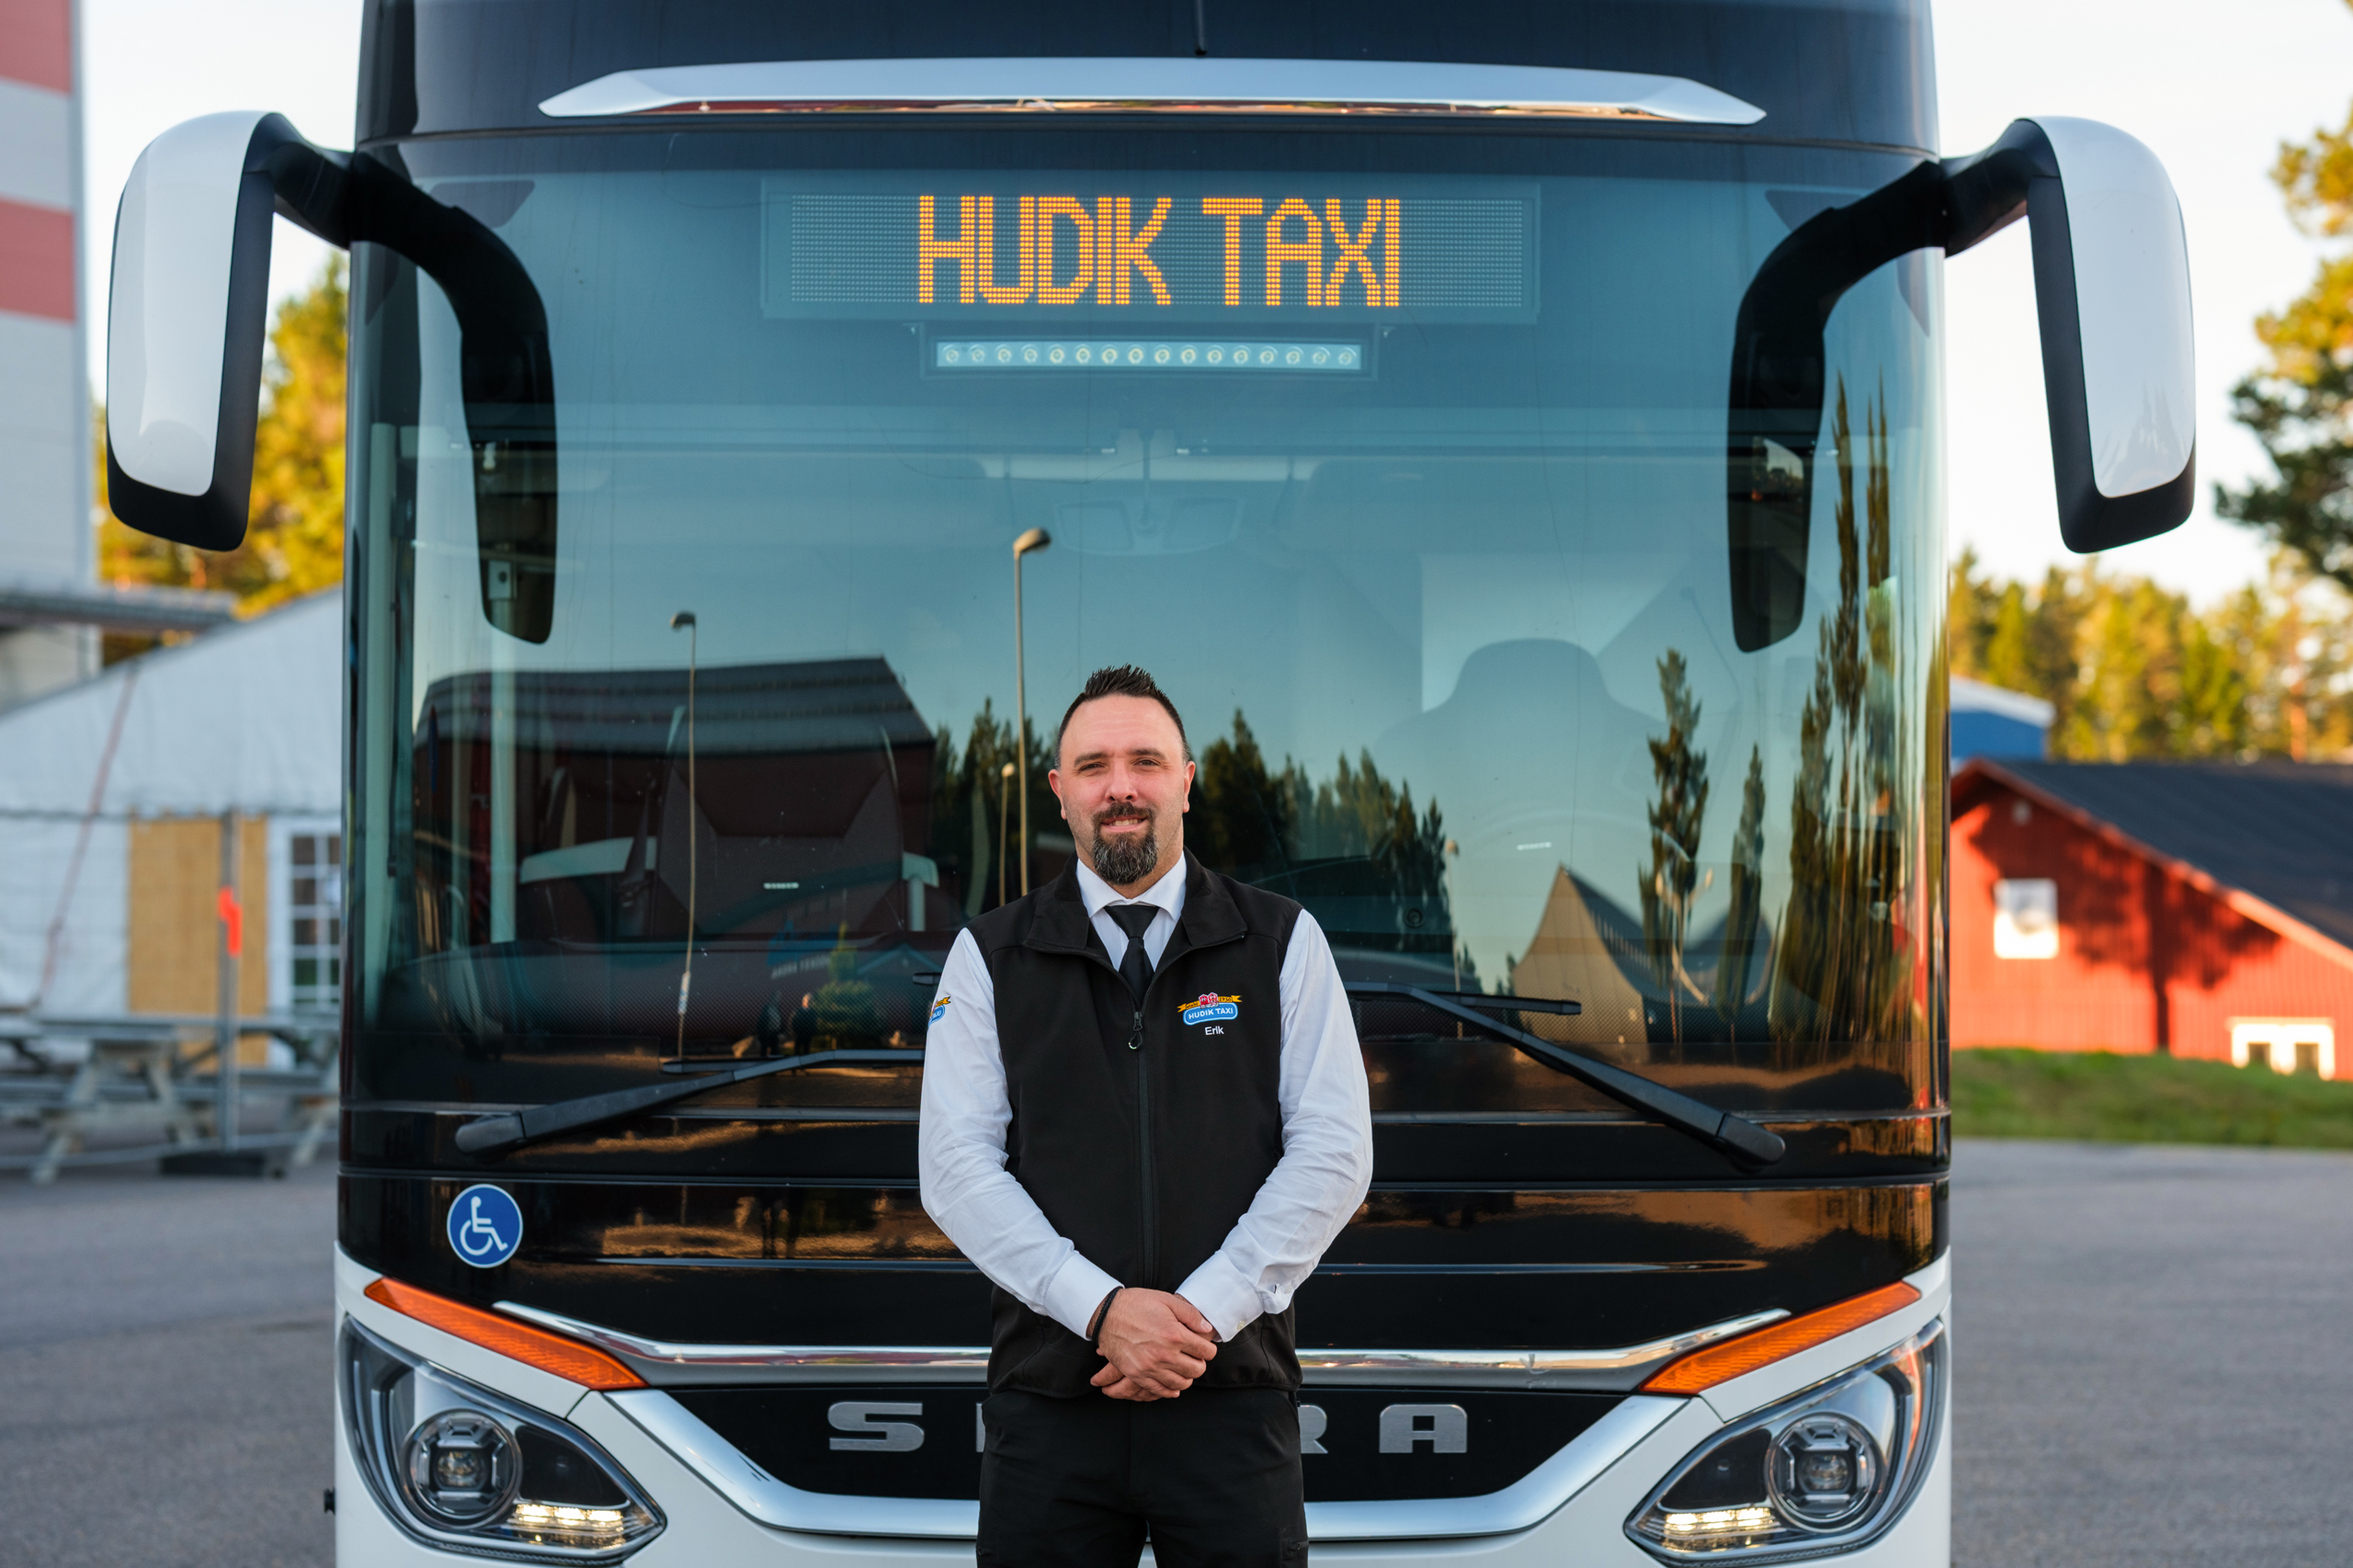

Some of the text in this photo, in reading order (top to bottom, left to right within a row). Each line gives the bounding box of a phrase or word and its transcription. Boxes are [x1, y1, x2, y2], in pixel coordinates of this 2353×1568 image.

[917, 194, 1401, 307] HUDIK TAXI
[1188, 1009, 1214, 1019] HUDIK
[1205, 1026, 1224, 1035] Erik
